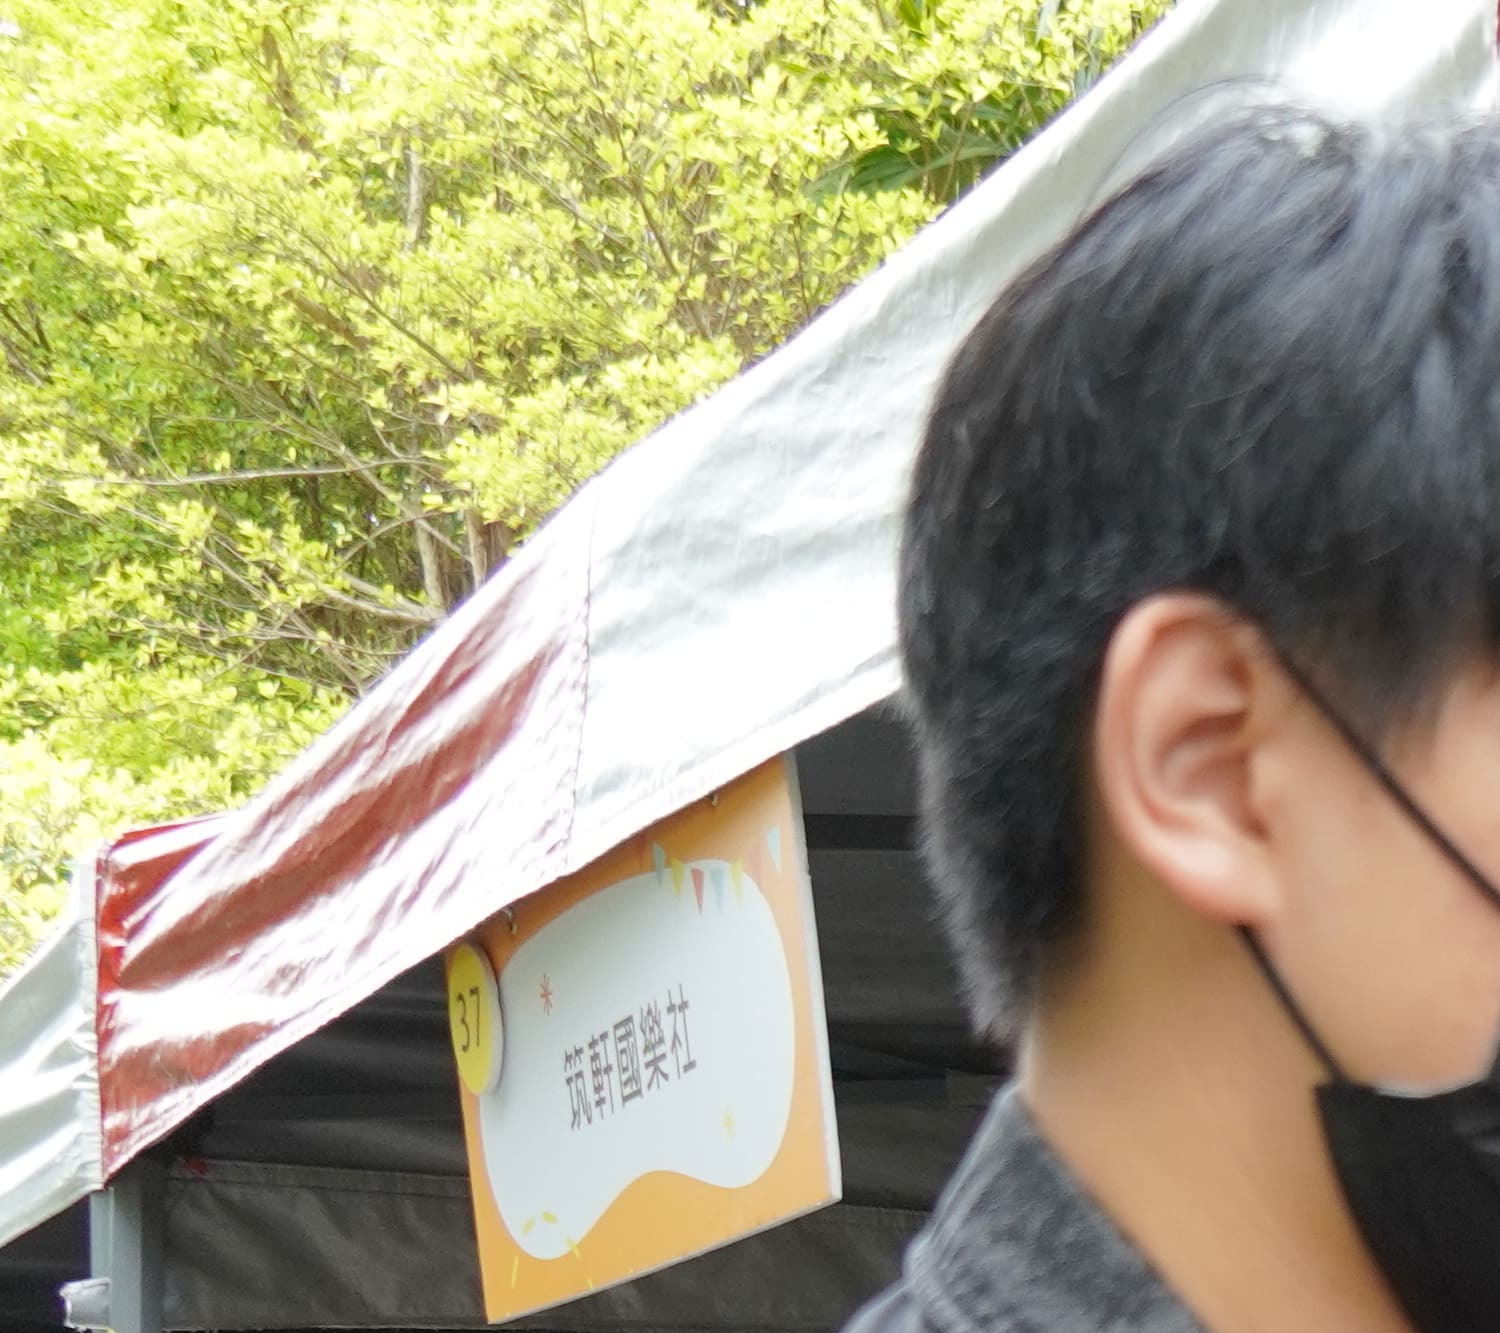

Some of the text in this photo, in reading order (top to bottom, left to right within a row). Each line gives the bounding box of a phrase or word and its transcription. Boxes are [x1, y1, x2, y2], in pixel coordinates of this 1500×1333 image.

[456, 986, 482, 1053] 37
[563, 983, 697, 1130] 筑軒國樂社
